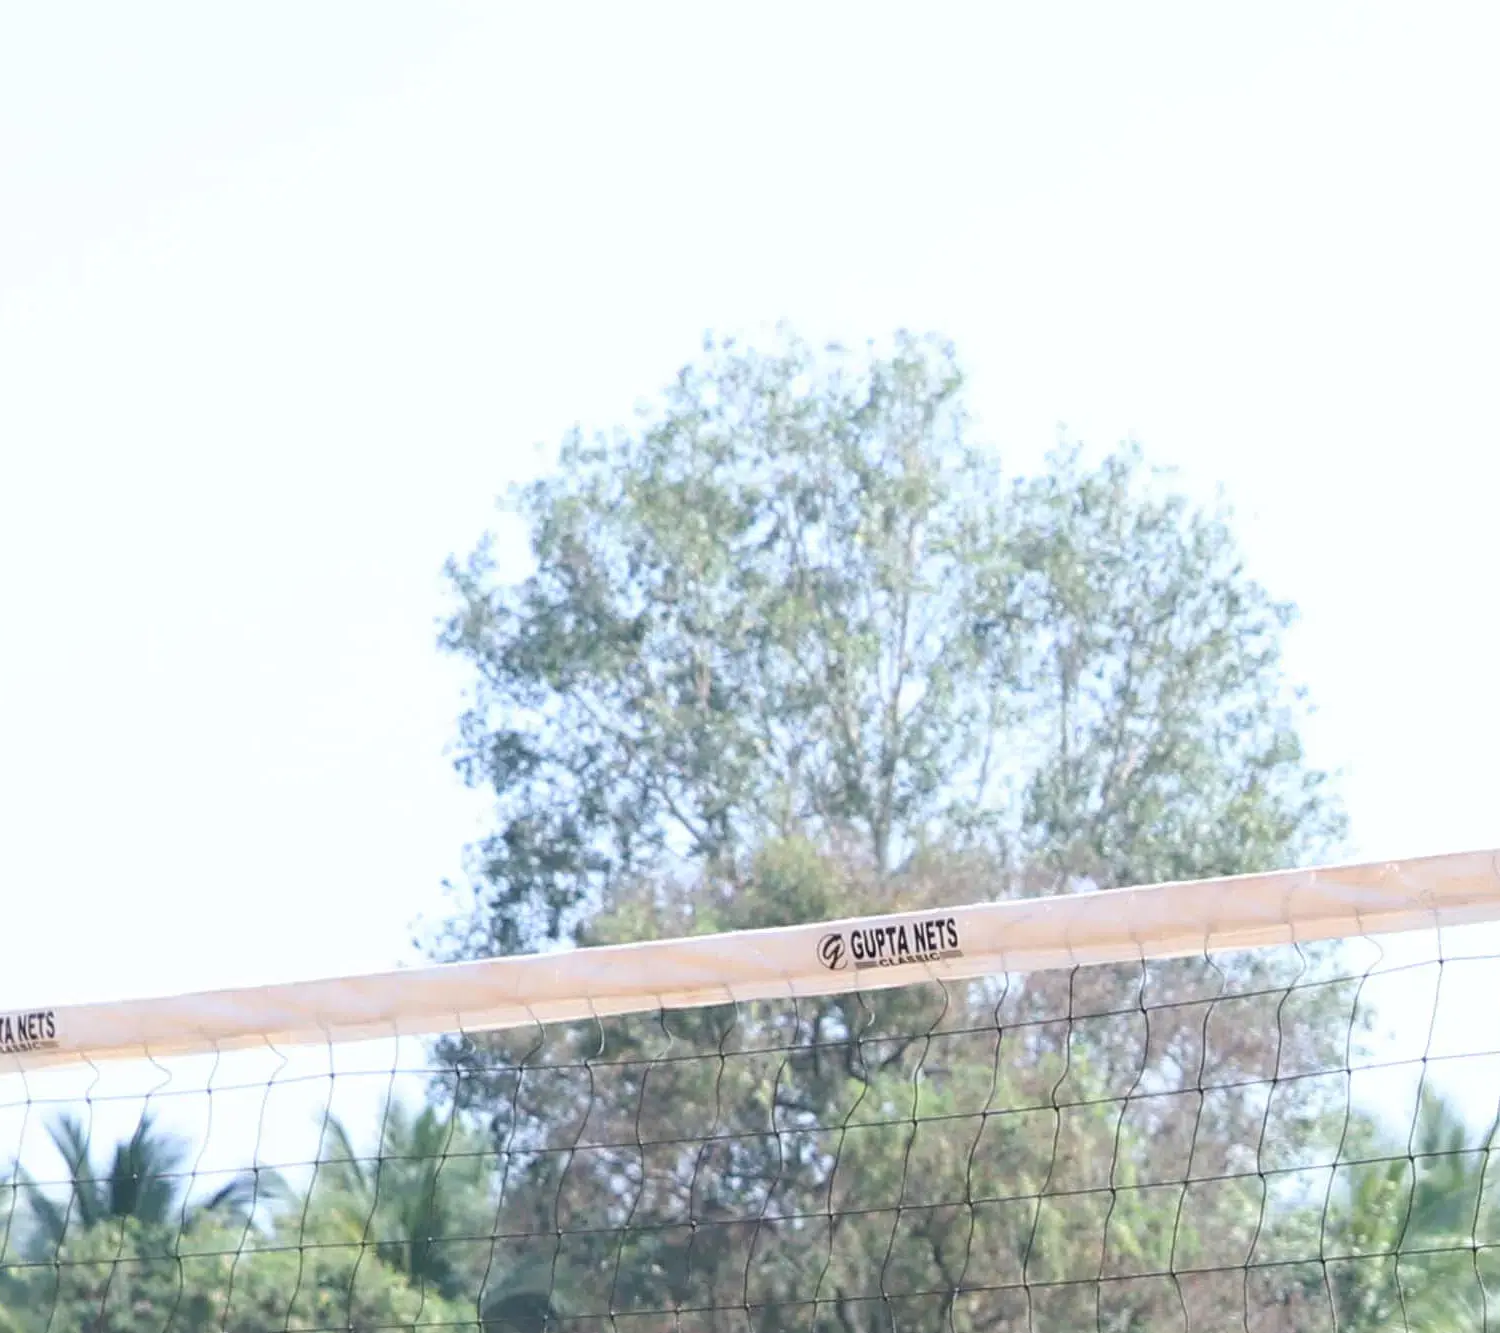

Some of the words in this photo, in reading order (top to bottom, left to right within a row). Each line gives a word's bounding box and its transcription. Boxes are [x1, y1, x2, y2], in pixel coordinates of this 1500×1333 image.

[851, 926, 909, 960] GUPTA
[913, 918, 958, 952] NETS
[879, 951, 940, 967] CLASSIC
[18, 1012, 55, 1042] NETS
